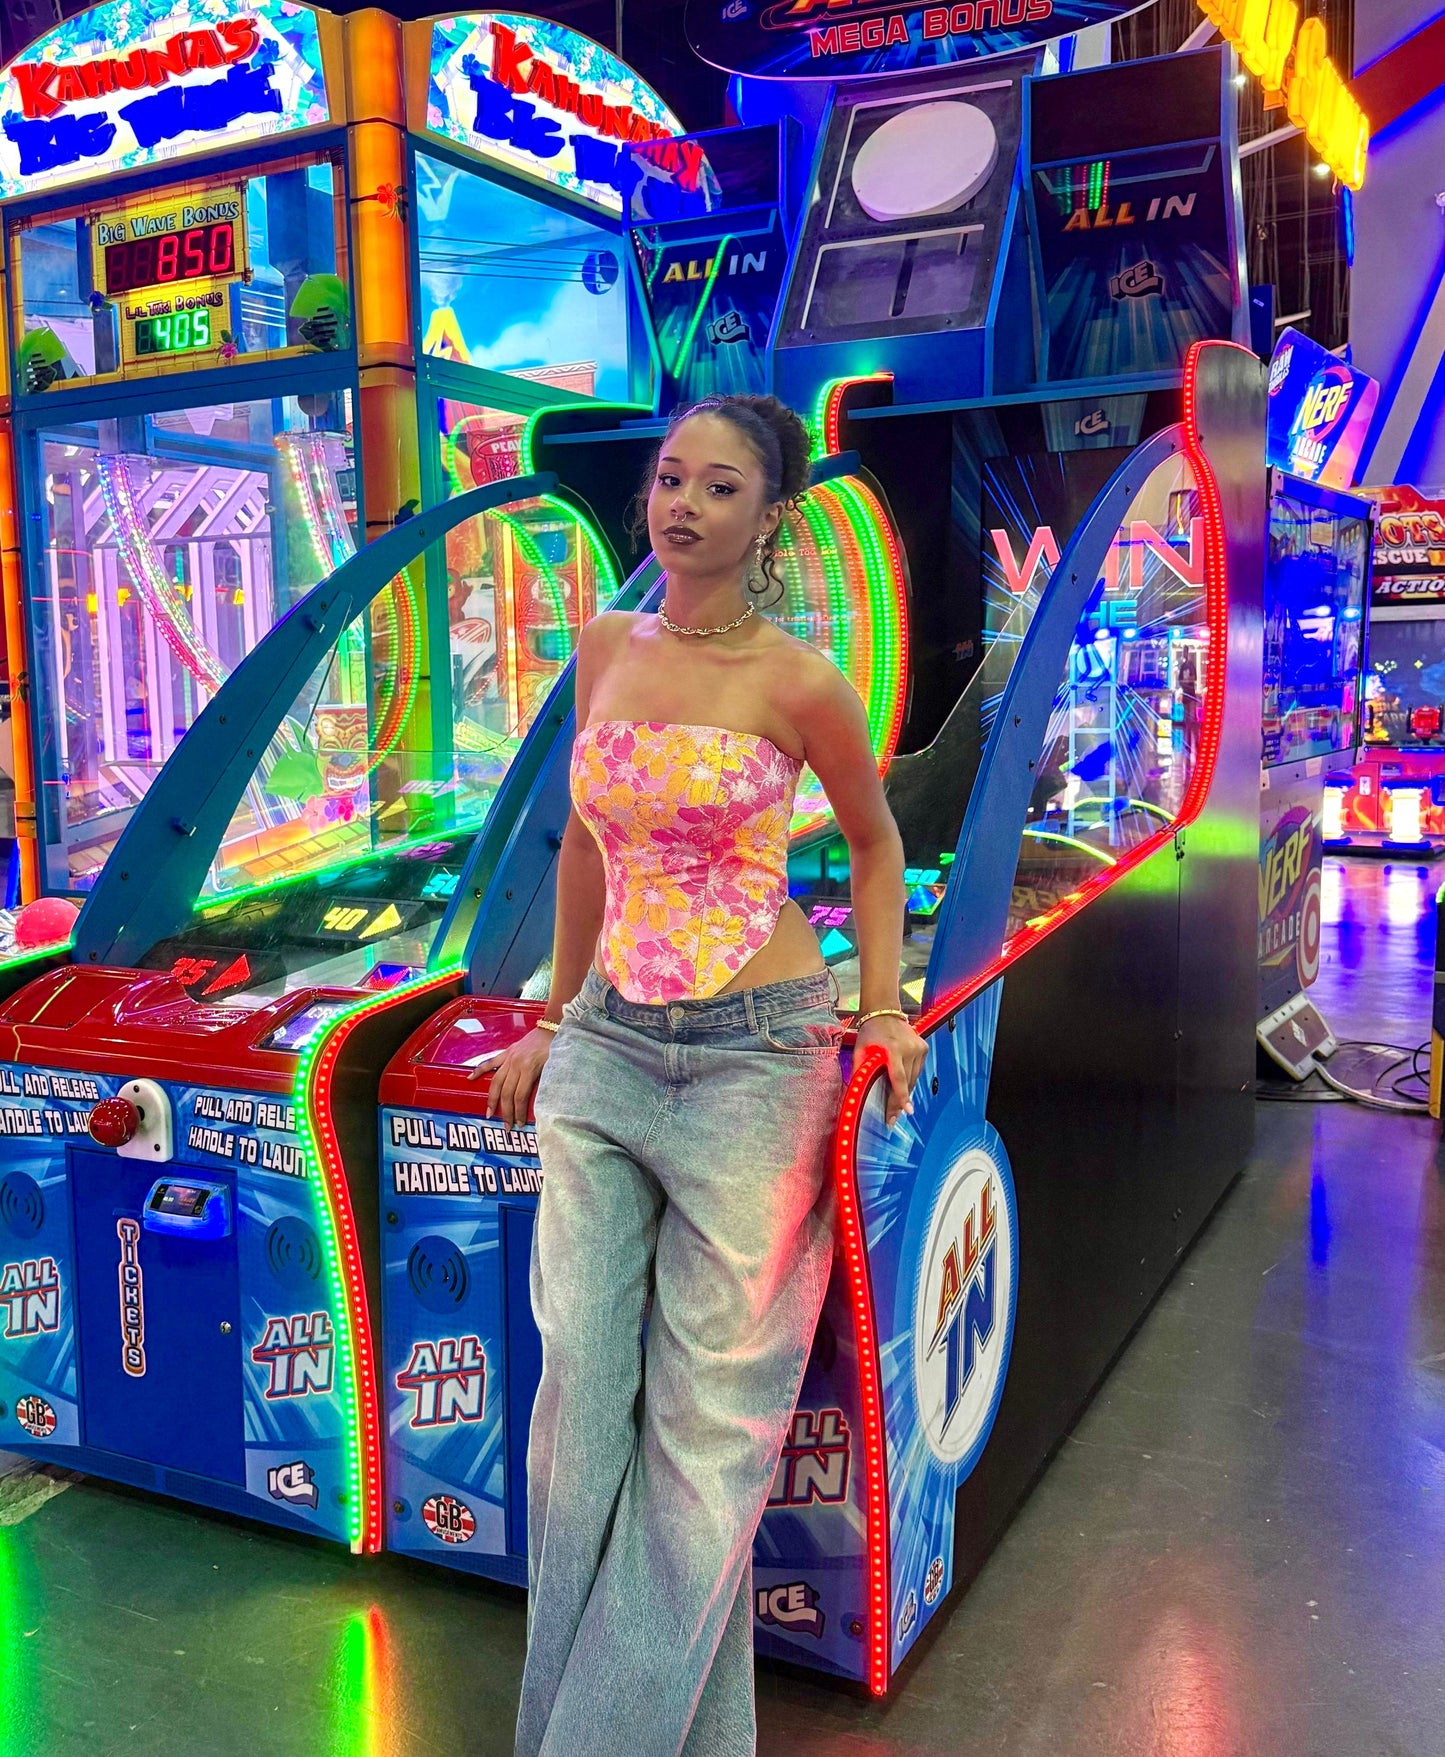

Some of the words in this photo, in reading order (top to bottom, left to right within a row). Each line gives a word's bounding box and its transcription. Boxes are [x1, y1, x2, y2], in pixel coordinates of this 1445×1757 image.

[809, 14, 910, 58] MEGA
[923, 0, 1053, 40] BONUS
[12, 18, 260, 119] KAHUNA'S
[98, 223, 126, 246] BIG
[131, 213, 177, 237] WAVE
[182, 201, 240, 228] BONUS
[1063, 201, 1136, 232] ALL
[1146, 192, 1198, 222] IN
[156, 224, 233, 282] 850
[661, 258, 720, 284] ALL
[728, 250, 767, 276] IN
[175, 291, 224, 311] BONUS
[1110, 261, 1165, 301] ICE
[155, 310, 209, 350] 405
[708, 311, 751, 346] ICE
[1073, 409, 1111, 436] ICE
[1291, 381, 1354, 435] NERF
[1375, 512, 1445, 548] OTS
[1375, 579, 1445, 594] ACTIO
[1257, 810, 1313, 925] NERF
[324, 906, 369, 931] 40
[808, 905, 853, 926] 75
[1258, 911, 1301, 959] ARCADE
[24, 1073, 49, 1096] AND
[51, 1076, 99, 1100] RELEASE
[0, 1108, 43, 1134] ANDLE
[44, 1110, 64, 1134] TO
[194, 1096, 223, 1119] PULL
[226, 1100, 252, 1123] AND
[188, 1126, 235, 1157] HANDLE
[239, 1136, 258, 1164] TO
[262, 1142, 307, 1178] LAUN
[392, 1117, 443, 1147] PULL
[448, 1123, 481, 1150] AND
[483, 1127, 539, 1154] RELEAS
[394, 1162, 470, 1193] HANDLE
[473, 1165, 499, 1193] TO
[935, 1175, 996, 1331] ALL
[2, 1257, 59, 1295] ALL
[5, 1290, 61, 1338] IN
[118, 1220, 144, 1377] TICKETS
[257, 1313, 334, 1352] ALL
[938, 1232, 998, 1443] IN
[266, 1347, 334, 1399] IN
[404, 1336, 487, 1378] ALL
[26, 1400, 46, 1427] GB
[410, 1370, 486, 1428] IN
[781, 1408, 851, 1450] LL
[268, 1462, 318, 1508] ICE
[766, 1449, 851, 1507] IN
[435, 1500, 462, 1531] GB
[756, 1582, 825, 1638] ICE
